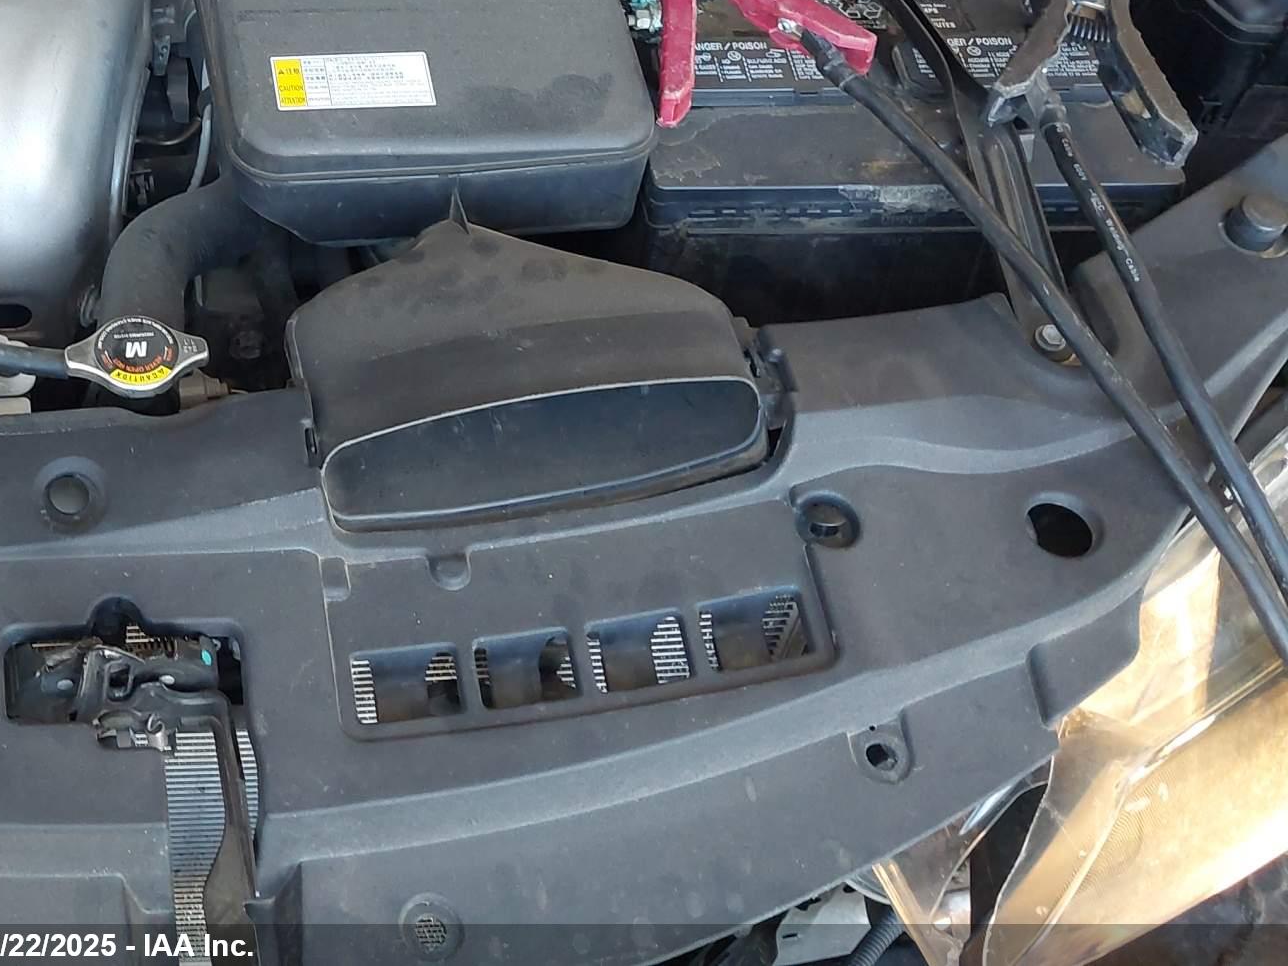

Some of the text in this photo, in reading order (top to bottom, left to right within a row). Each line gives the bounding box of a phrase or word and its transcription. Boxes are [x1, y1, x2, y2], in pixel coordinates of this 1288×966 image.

[732, 41, 767, 51] POISON
[975, 37, 1013, 46] POISON
[278, 84, 304, 93] CAUTION
[1125, 258, 1140, 282] Cable
[126, 341, 147, 358] M
